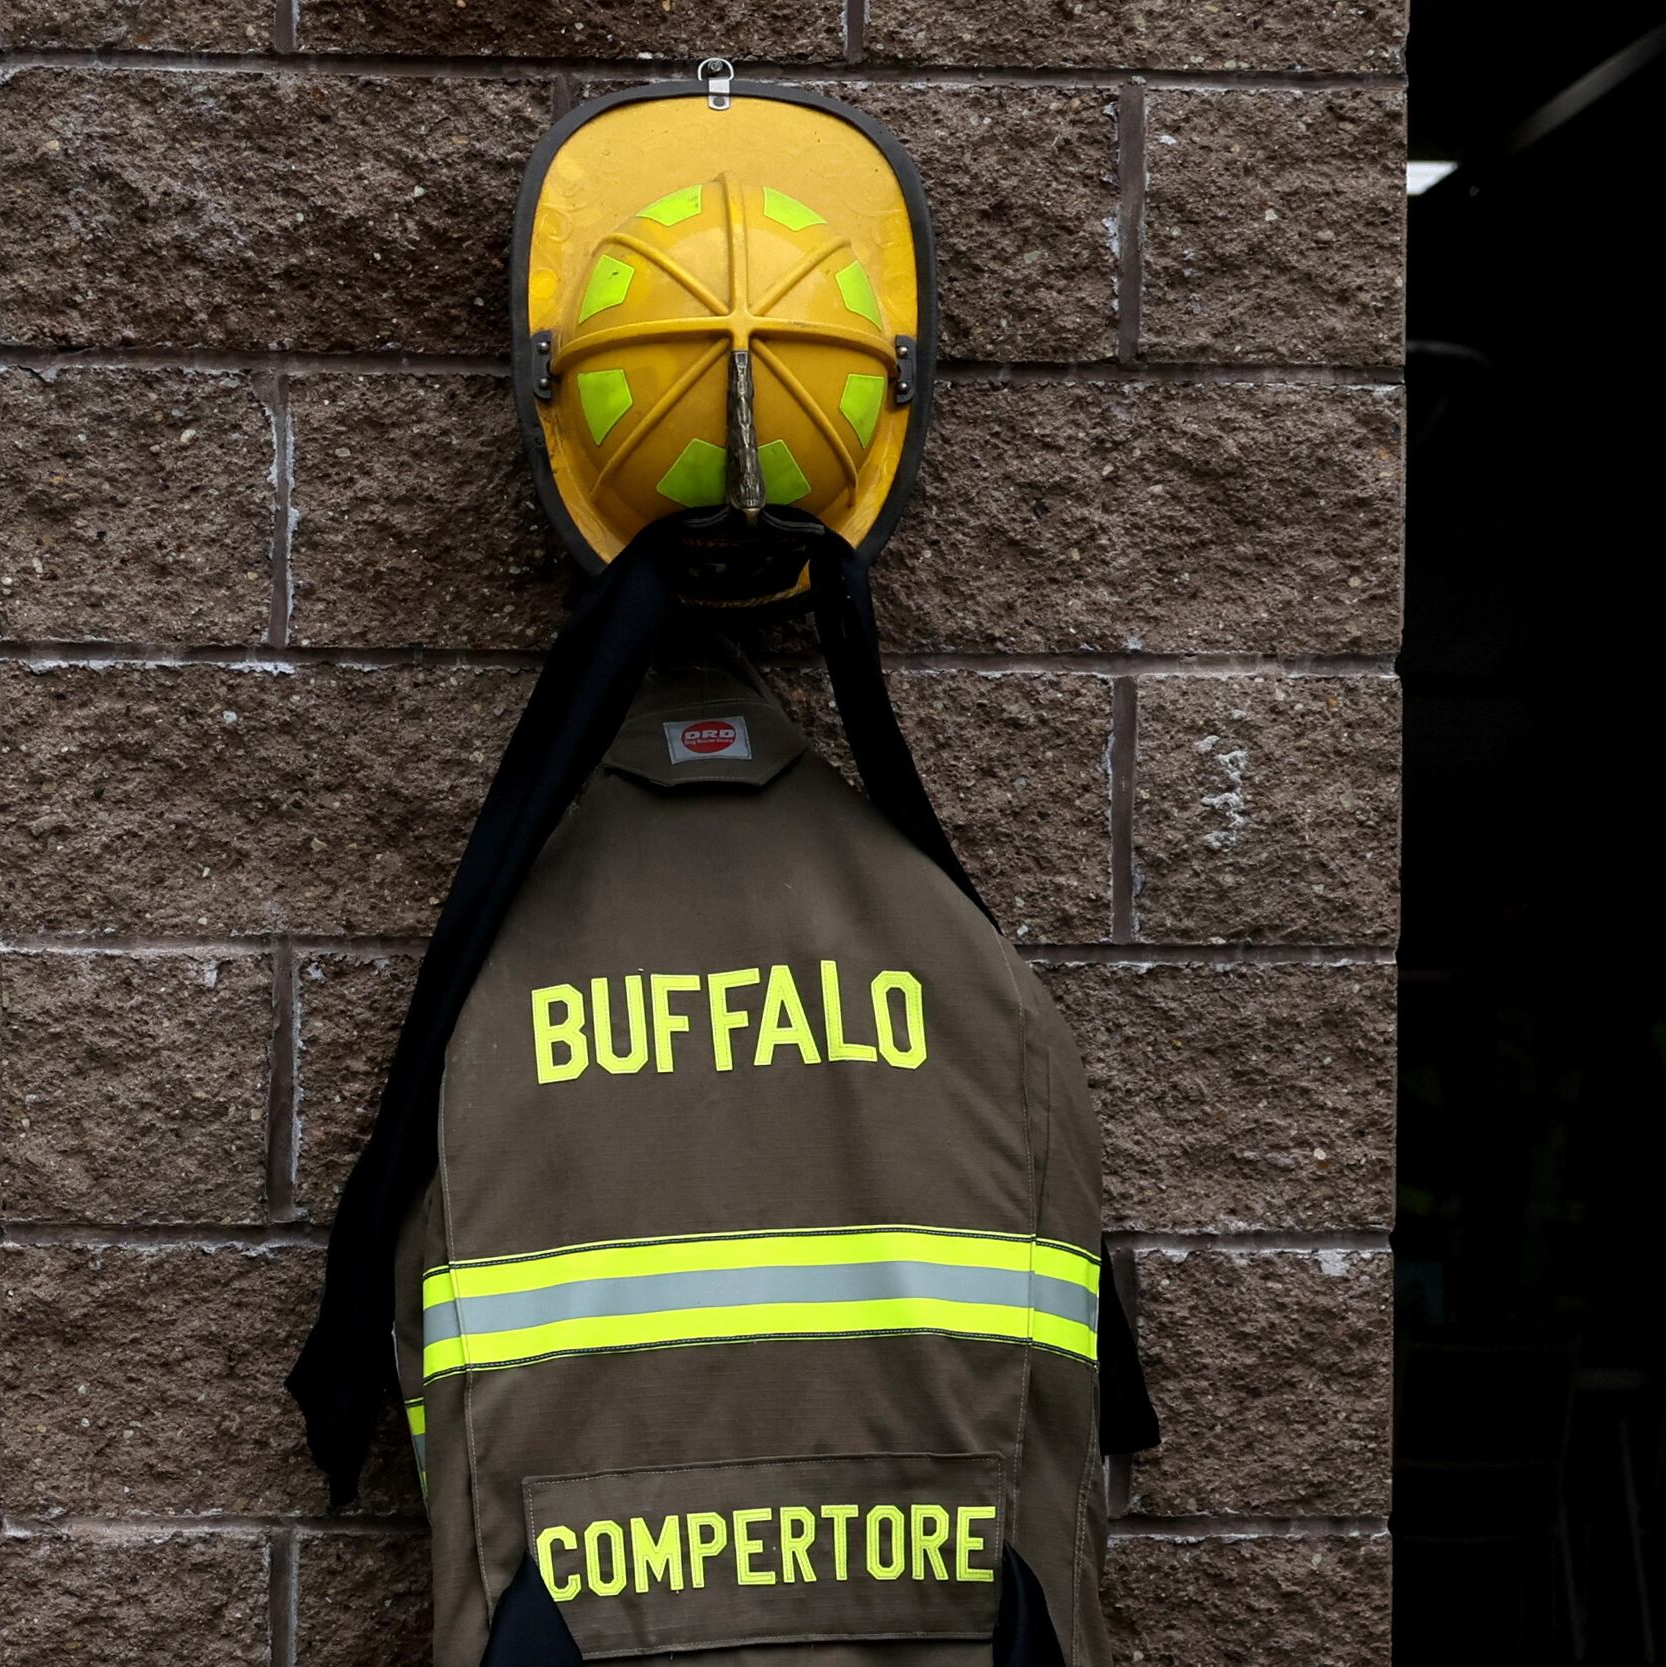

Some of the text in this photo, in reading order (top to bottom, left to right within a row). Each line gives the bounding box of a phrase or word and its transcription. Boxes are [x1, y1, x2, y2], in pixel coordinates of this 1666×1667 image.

[685, 730, 735, 740] DRD
[532, 960, 928, 1084] BUFFALO
[536, 1504, 997, 1602] COMPERTORE
